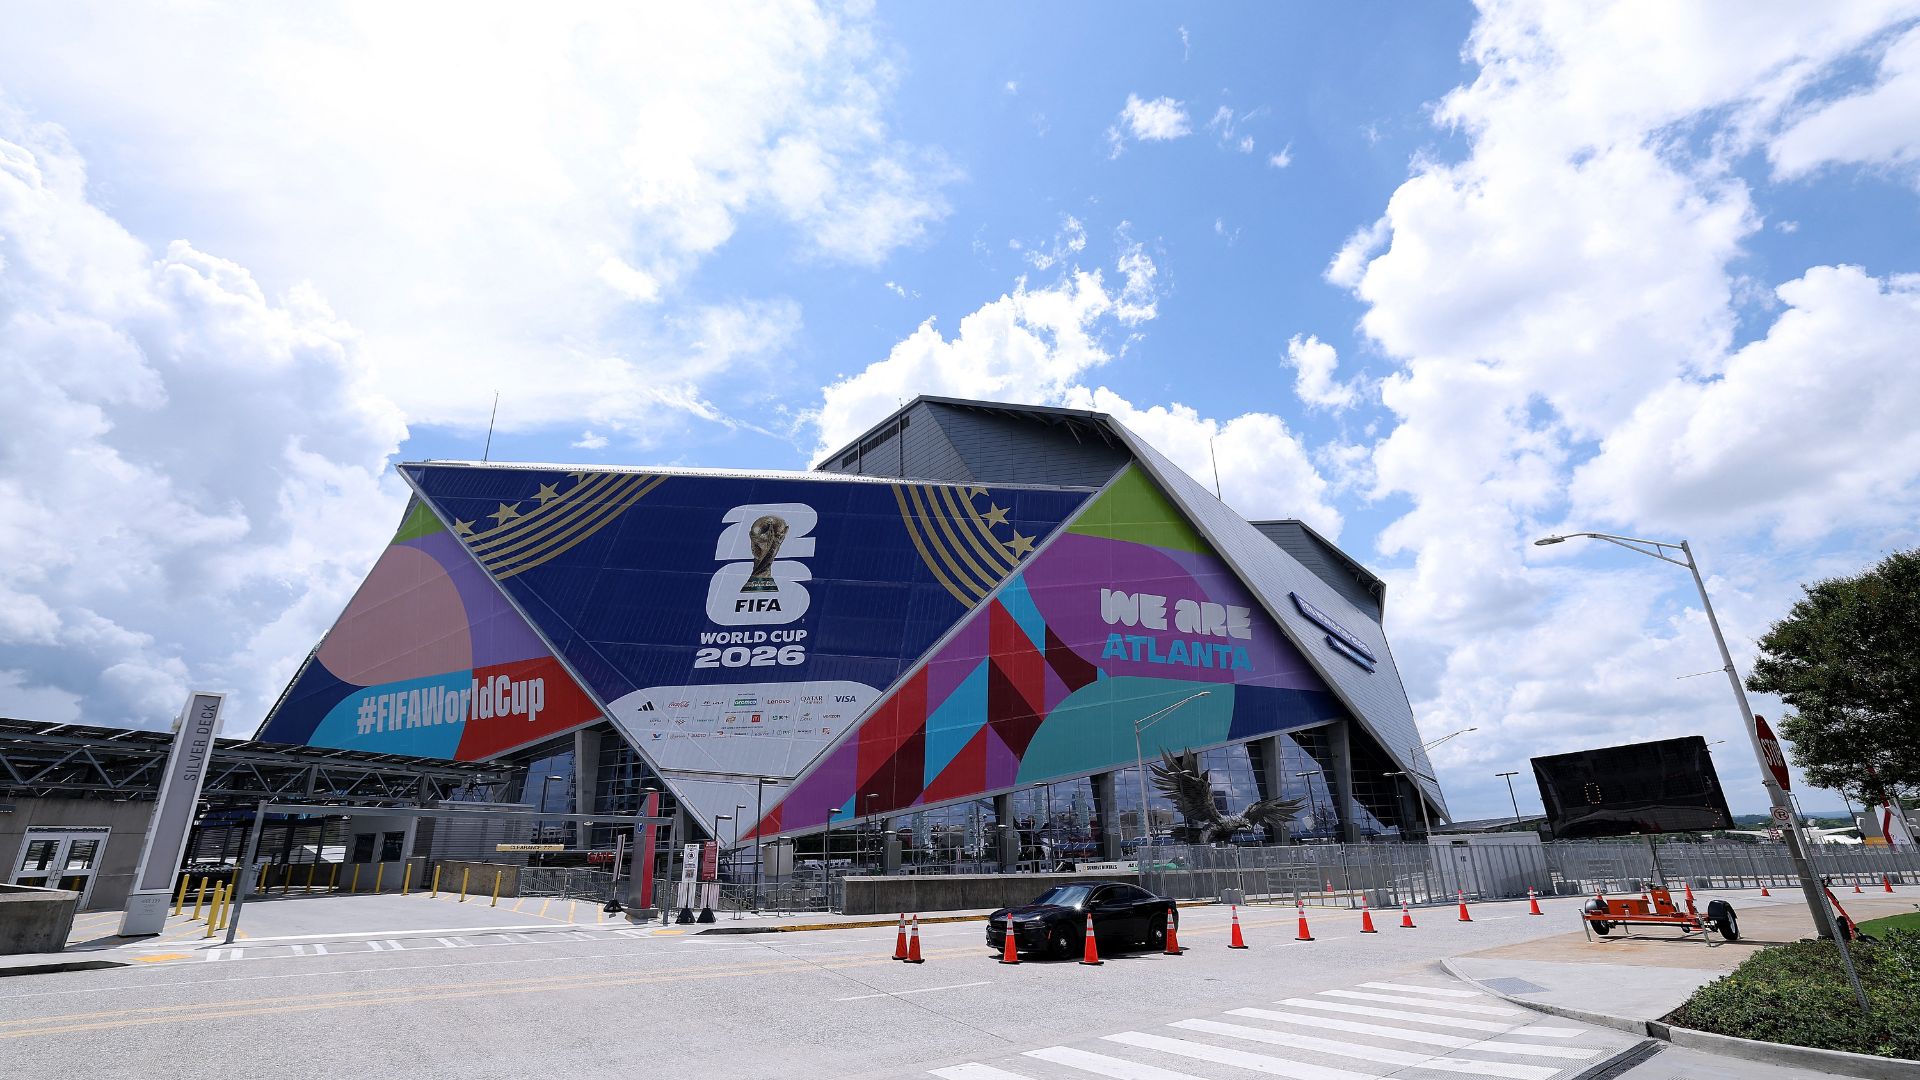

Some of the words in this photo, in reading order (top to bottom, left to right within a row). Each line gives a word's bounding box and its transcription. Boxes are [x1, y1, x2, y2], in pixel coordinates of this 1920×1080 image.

[735, 599, 781, 613] FIFA
[1101, 588, 1168, 630] WE
[700, 631, 767, 645] WORLD
[770, 630, 808, 643] CUP
[1101, 633, 1253, 672] ATLANTA
[694, 645, 806, 668] 2026
[357, 675, 545, 735] #FIFAWorldCup
[183, 740, 207, 781] SILVER
[196, 704, 217, 734] DECK
[1759, 738, 1784, 767] STOP
